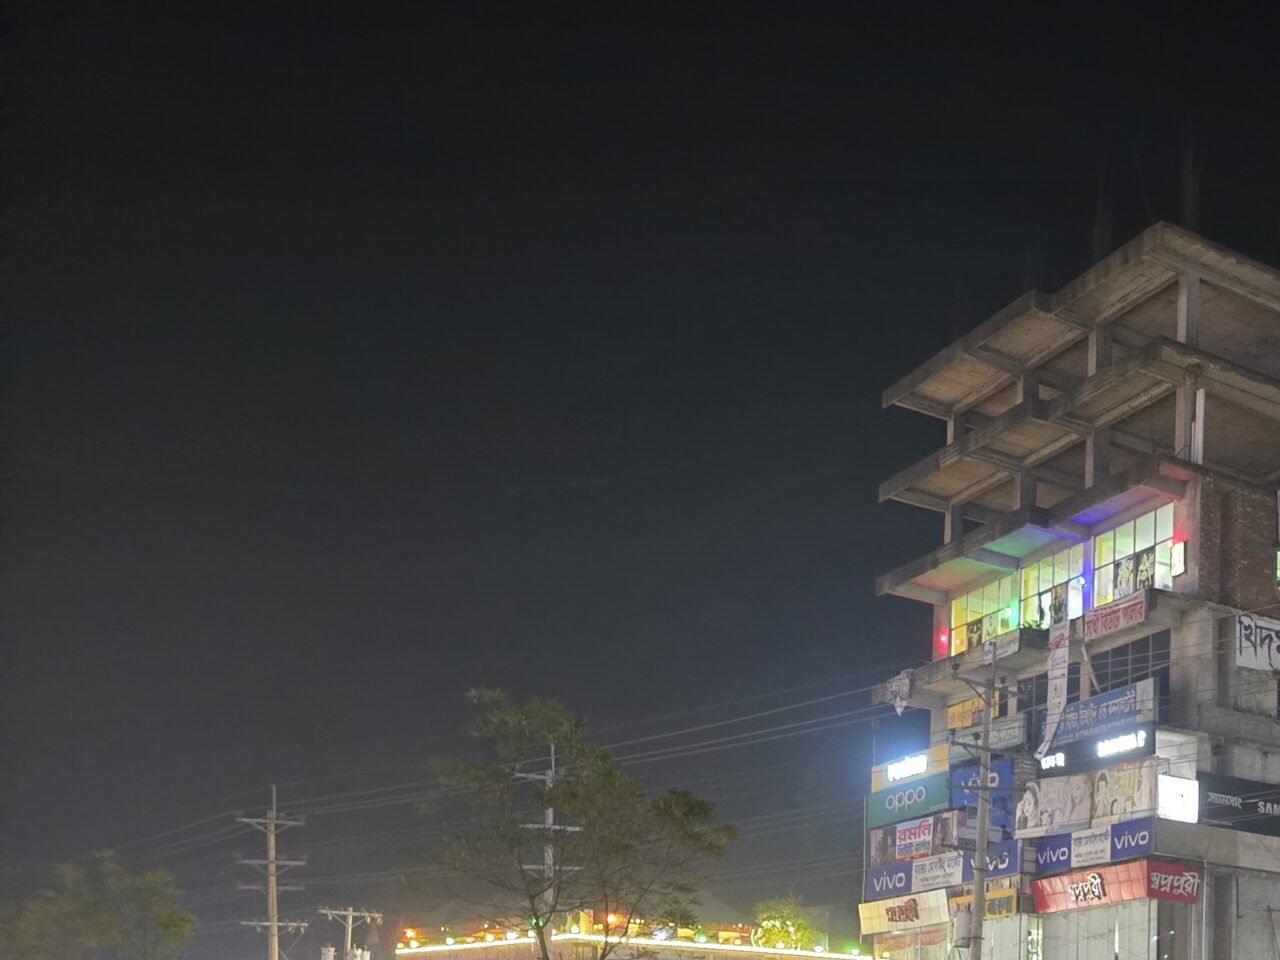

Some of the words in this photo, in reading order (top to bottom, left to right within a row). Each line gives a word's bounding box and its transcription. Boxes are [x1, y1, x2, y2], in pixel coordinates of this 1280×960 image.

[885, 785, 926, 814] oppo
[1114, 830, 1150, 850] vivo
[970, 852, 1009, 873] vvo
[1037, 846, 1069, 864] vivo
[873, 871, 906, 892] vivo
[1149, 871, 1200, 898] স্বপ্নপুরী
